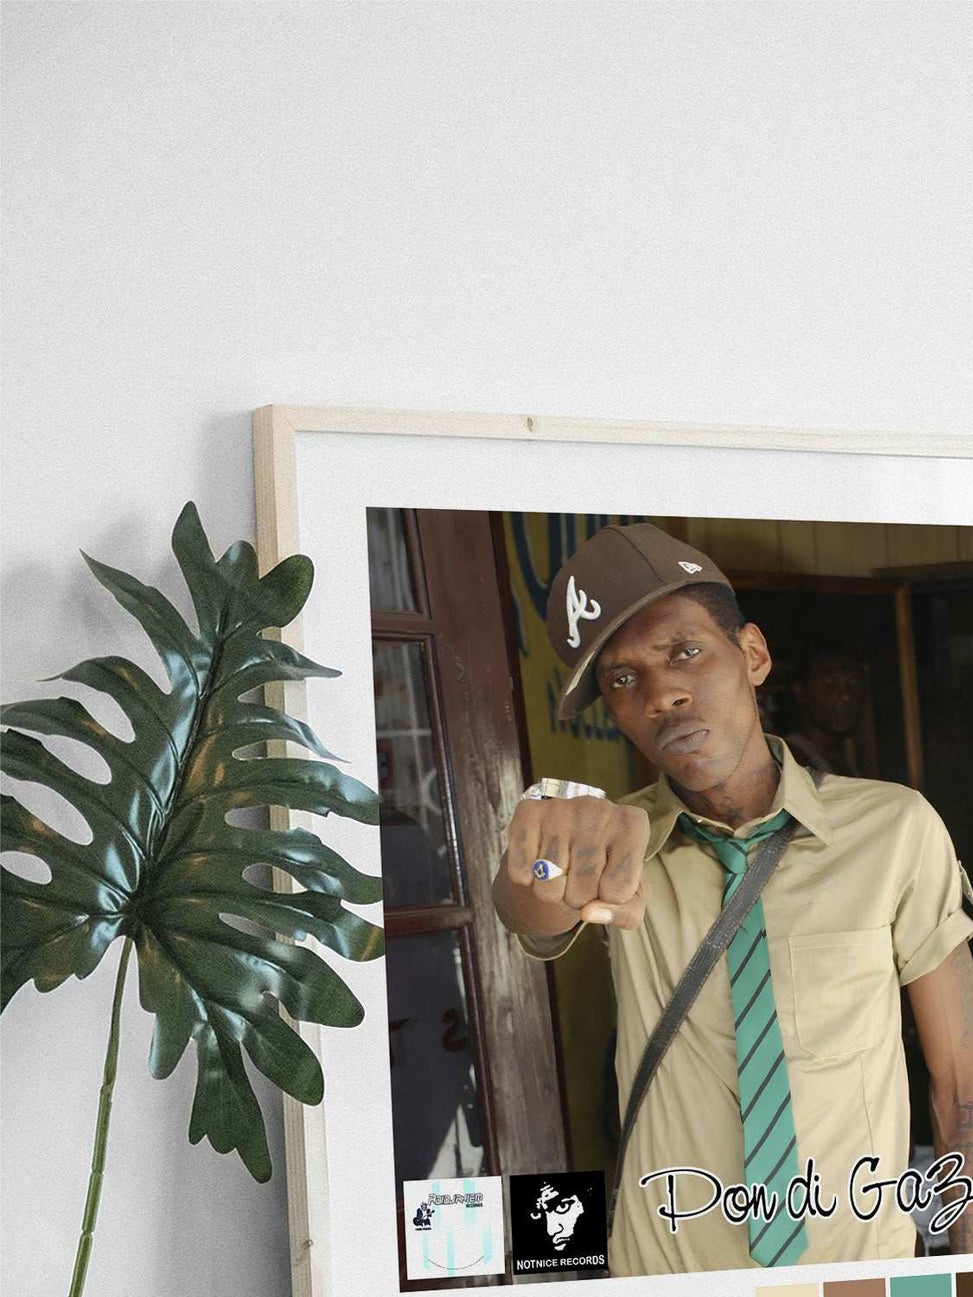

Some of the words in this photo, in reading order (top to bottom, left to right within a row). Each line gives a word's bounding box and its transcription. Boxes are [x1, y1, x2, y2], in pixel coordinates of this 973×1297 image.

[640, 1167, 778, 1233] Pon
[788, 1157, 836, 1220] di
[516, 1257, 558, 1271] NOTNICE
[560, 1254, 605, 1267] RECORDS
